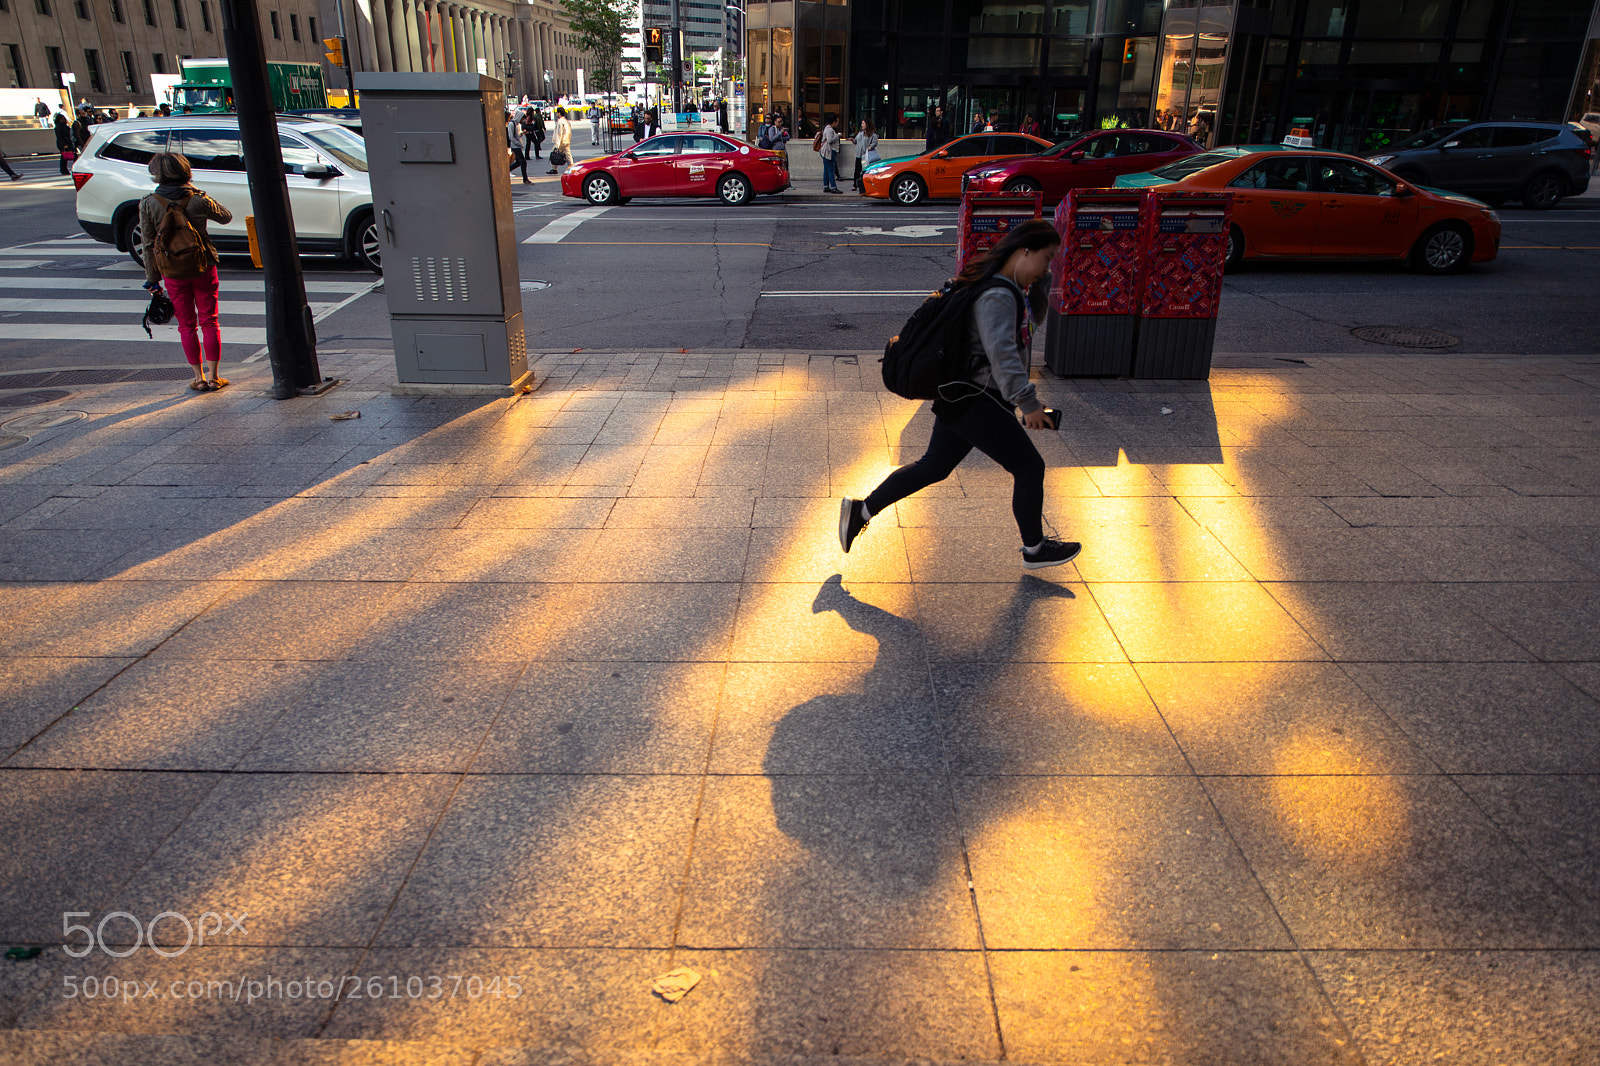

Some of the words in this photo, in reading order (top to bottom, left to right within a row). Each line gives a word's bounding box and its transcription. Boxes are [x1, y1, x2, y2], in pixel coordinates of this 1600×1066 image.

[1096, 249, 1112, 266] S4N
[1179, 254, 1196, 270] S4N
[1108, 269, 1124, 284] E4P
[1191, 272, 1207, 288] E4P
